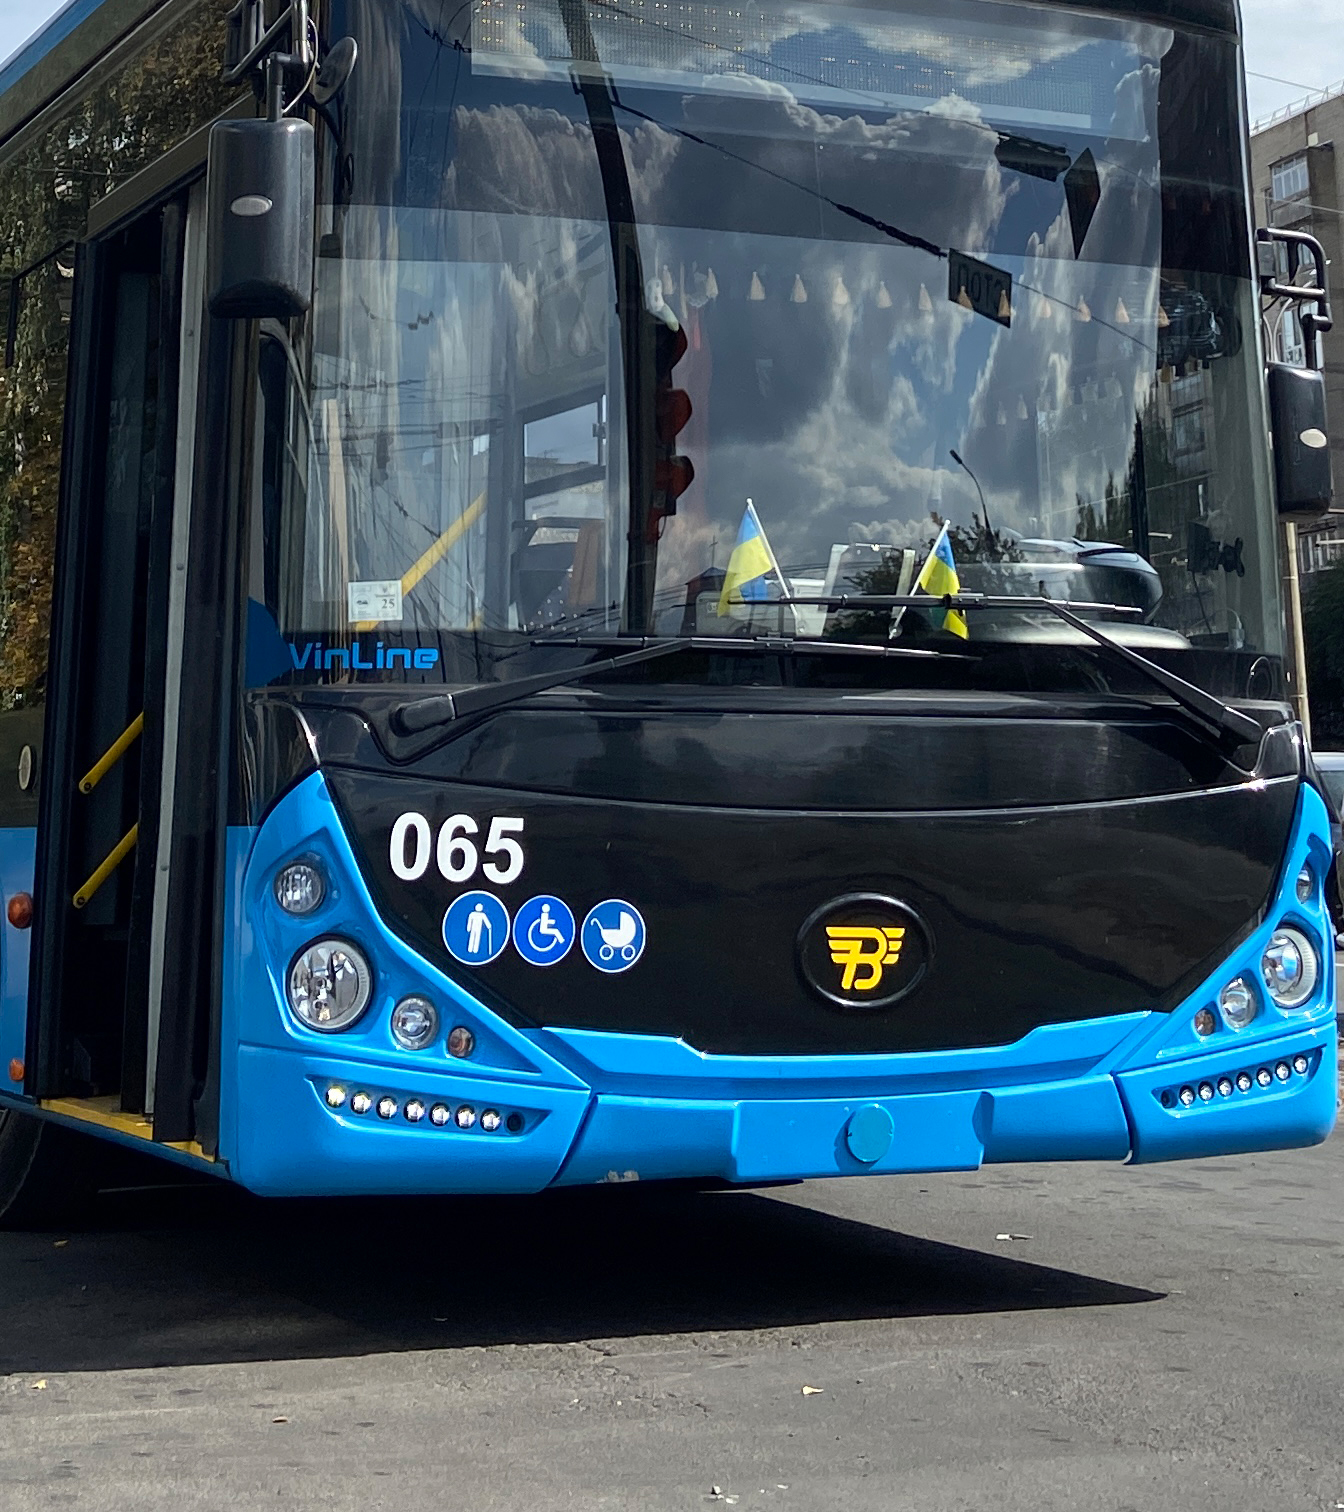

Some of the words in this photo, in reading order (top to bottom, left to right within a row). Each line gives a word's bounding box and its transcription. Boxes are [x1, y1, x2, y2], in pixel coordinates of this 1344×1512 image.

[381, 598, 396, 609] 25
[289, 642, 439, 669] VinLine
[389, 811, 524, 884] 065
